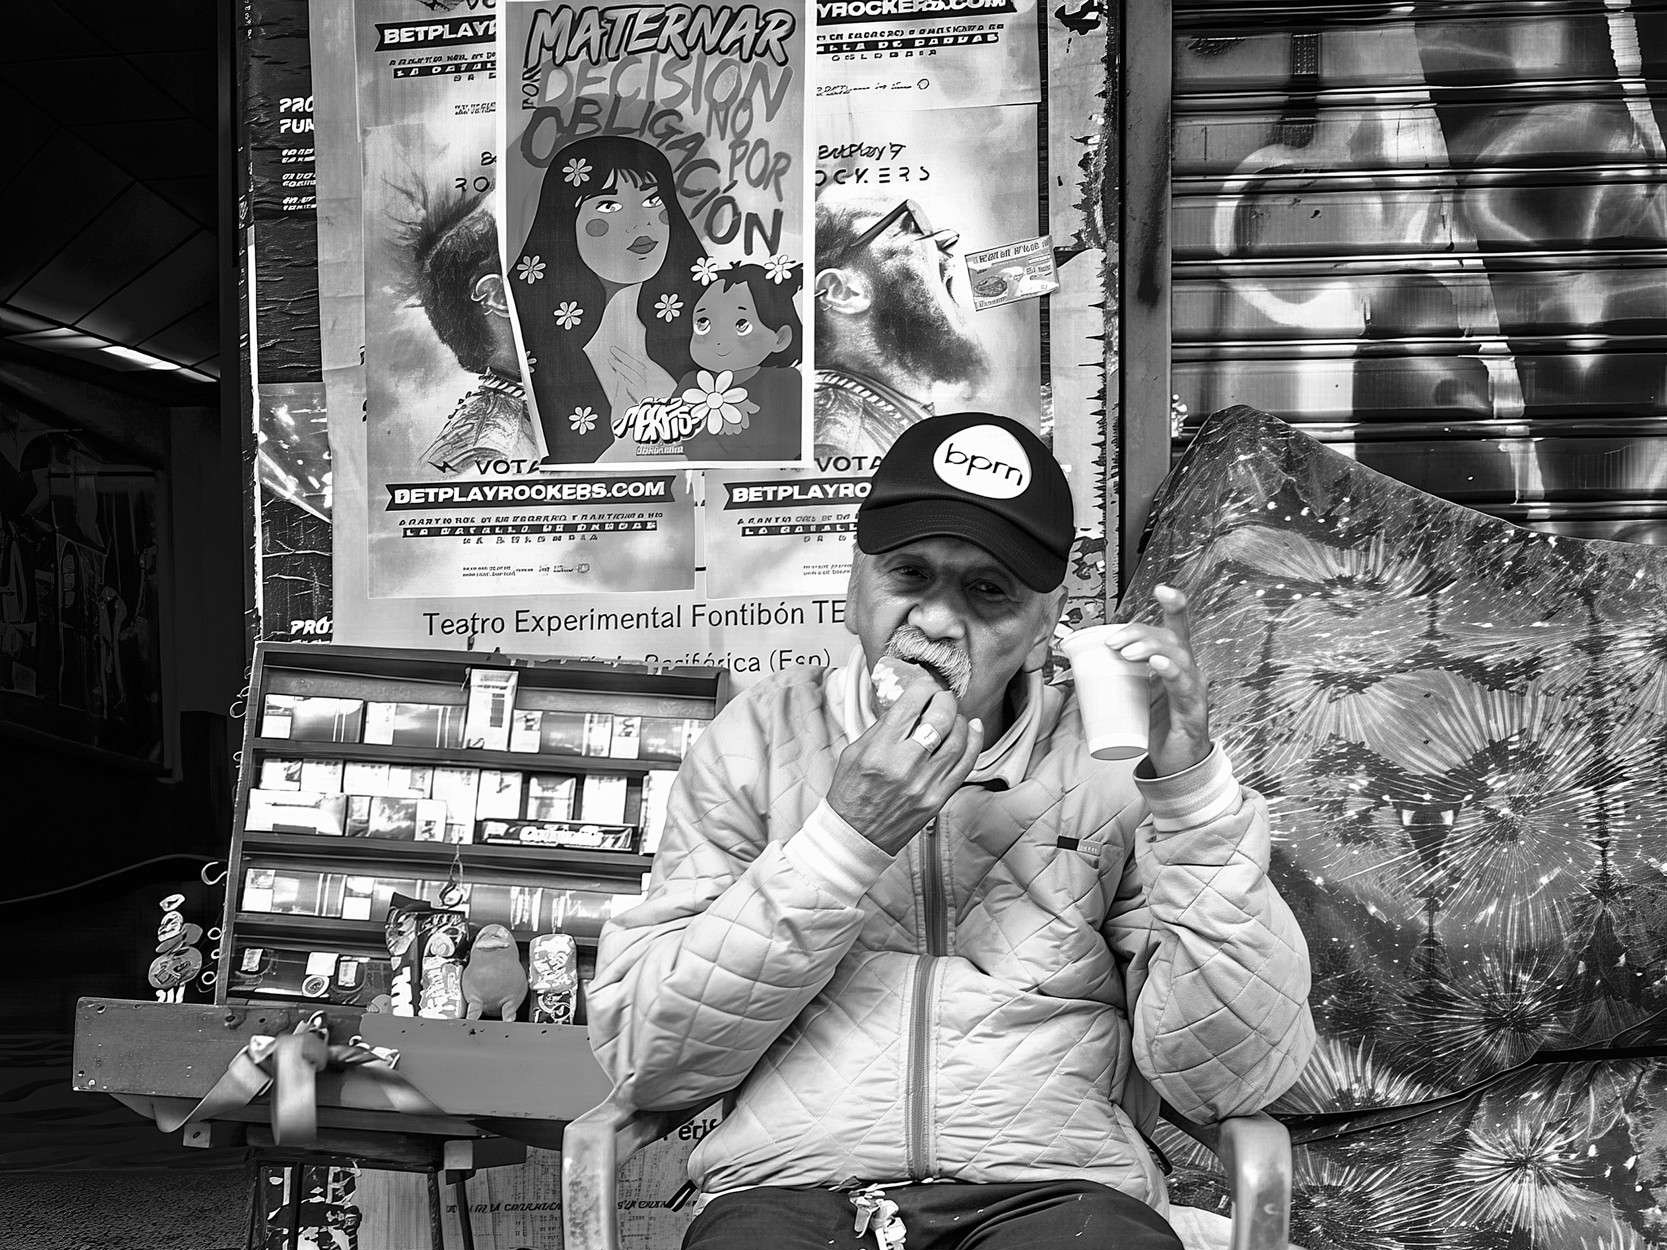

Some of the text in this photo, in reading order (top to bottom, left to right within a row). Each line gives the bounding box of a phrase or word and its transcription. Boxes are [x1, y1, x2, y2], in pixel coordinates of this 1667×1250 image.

[523, 3, 797, 67] MATERNAR
[706, 97, 754, 141] NO
[728, 138, 792, 202] POR
[944, 442, 1023, 487] bpm
[423, 611, 506, 637] Teatro
[514, 604, 682, 637] Experimental
[692, 600, 805, 628] Fontibón
